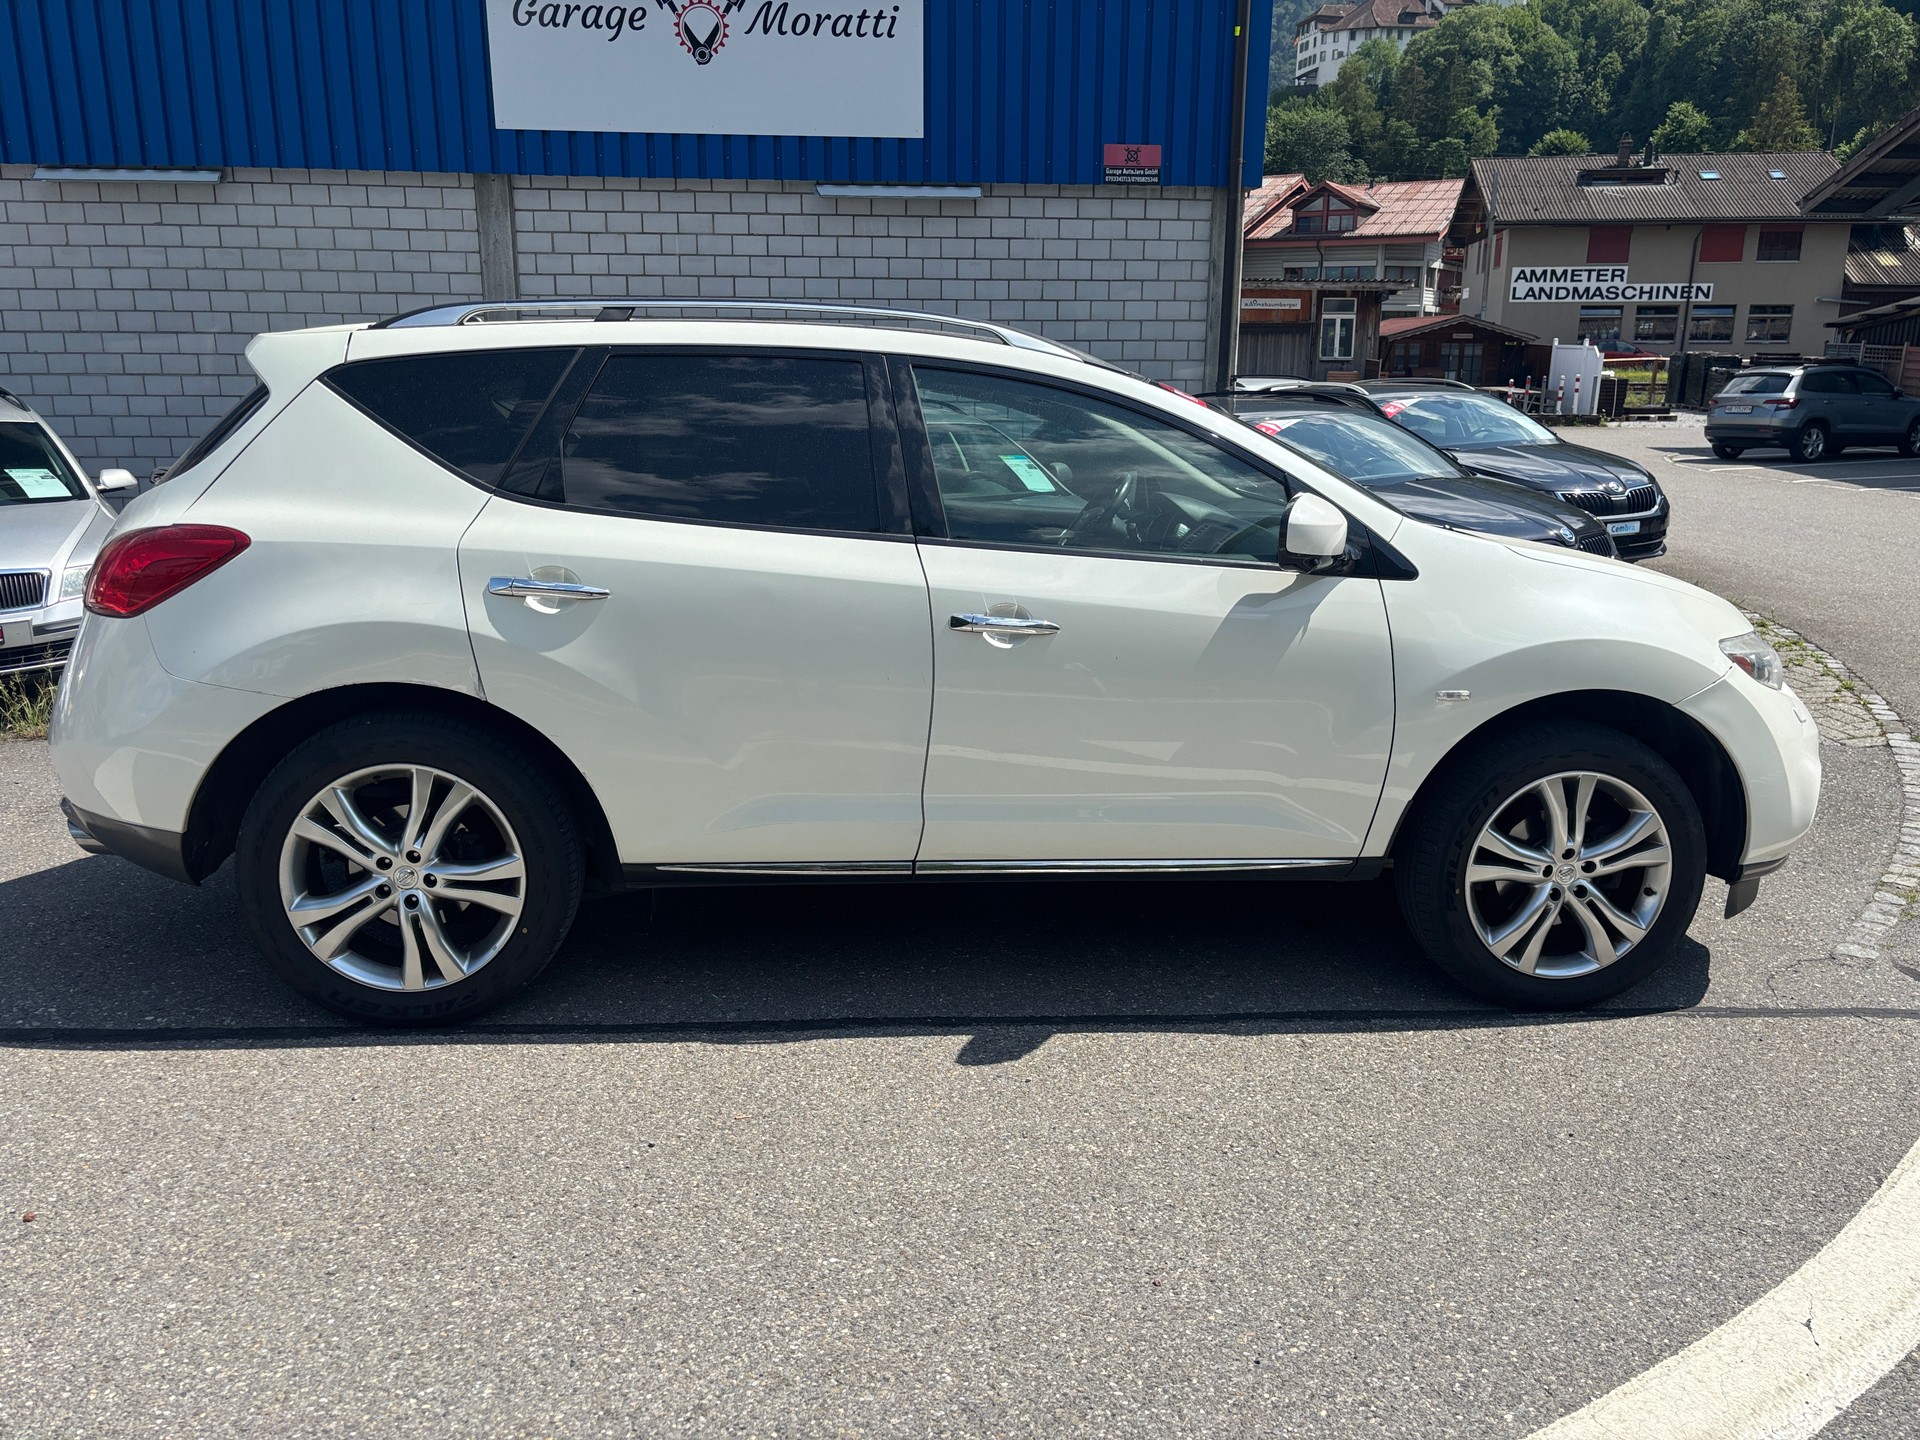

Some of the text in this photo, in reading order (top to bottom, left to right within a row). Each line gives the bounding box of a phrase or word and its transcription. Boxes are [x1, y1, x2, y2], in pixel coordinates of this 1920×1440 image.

[512, 0, 901, 42] Garage Moratti
[1105, 167, 1122, 175] Garage
[1513, 268, 1626, 283] AMMETER
[1511, 285, 1711, 300] LANDMASCHINEN
[1611, 524, 1635, 533] Cembra
